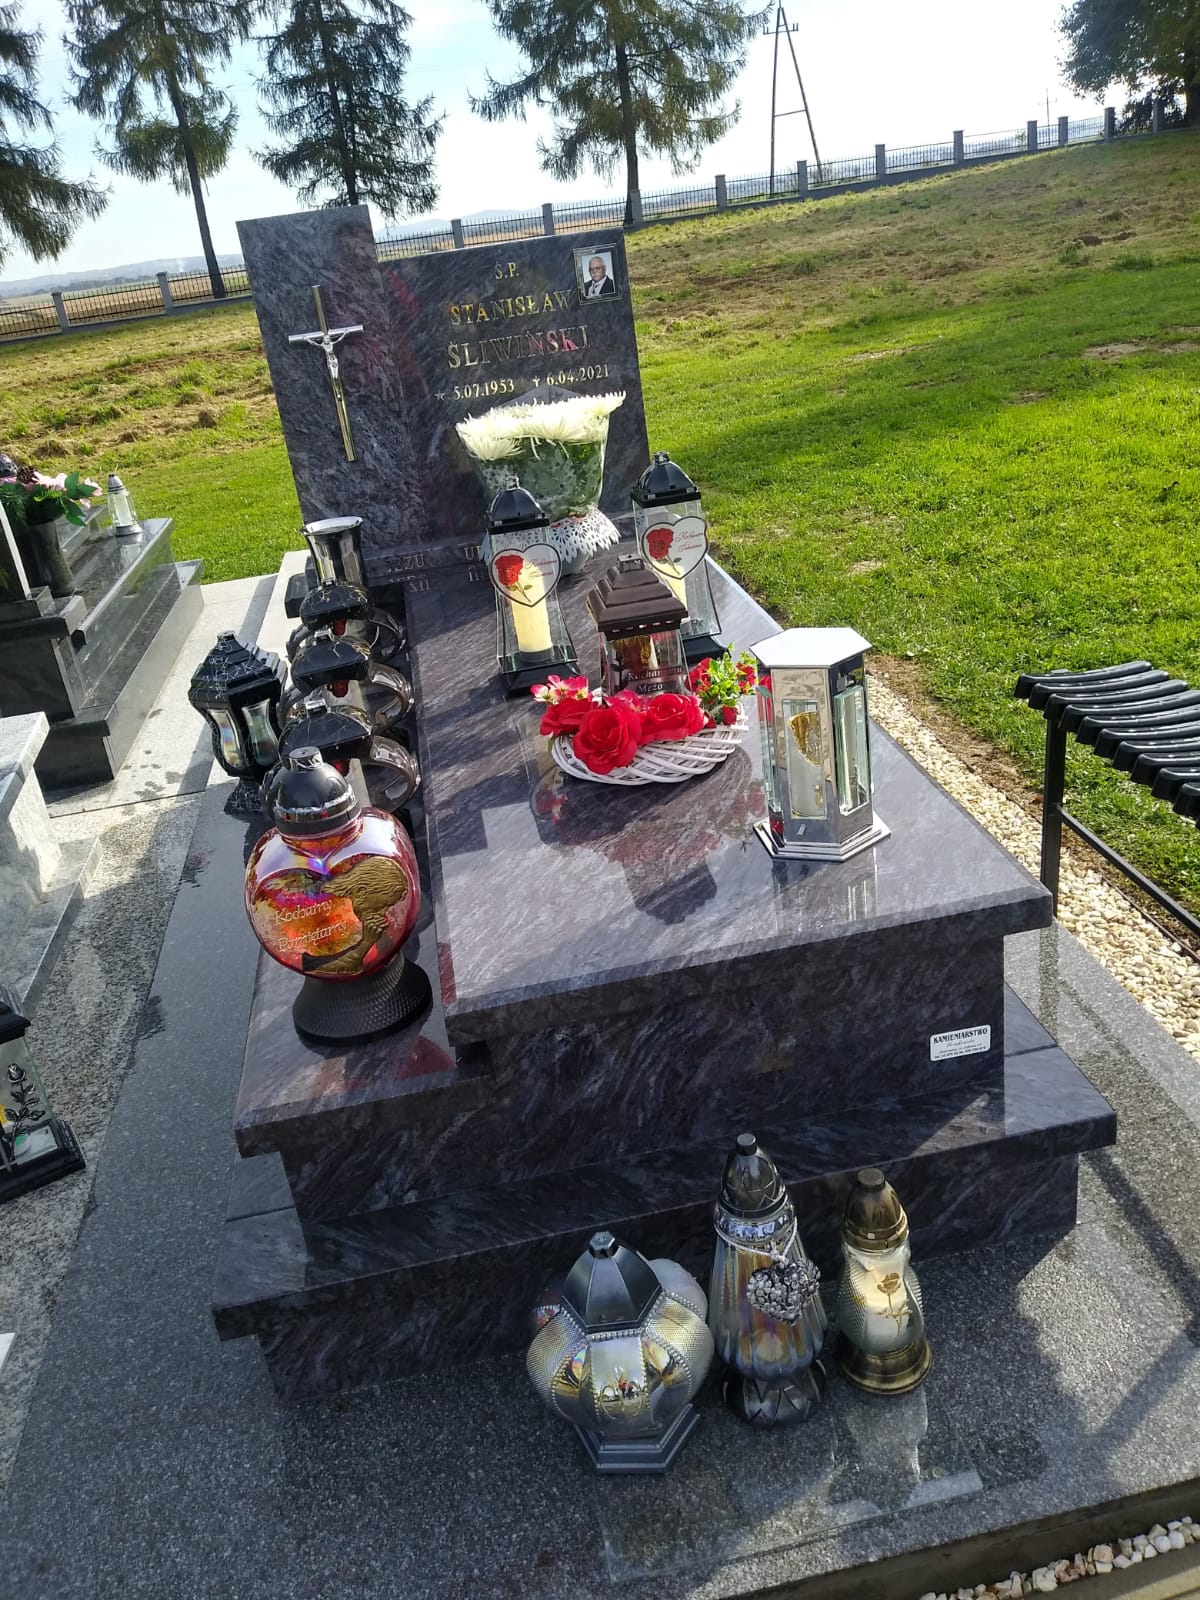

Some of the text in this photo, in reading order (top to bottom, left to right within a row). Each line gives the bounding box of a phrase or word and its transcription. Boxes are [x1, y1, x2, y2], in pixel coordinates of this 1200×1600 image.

[450, 289, 572, 326] STANISŁAW
[447, 325, 590, 369] ŚLIWIŃSKI
[453, 363, 609, 400] 5.07.1953 6.04.2021
